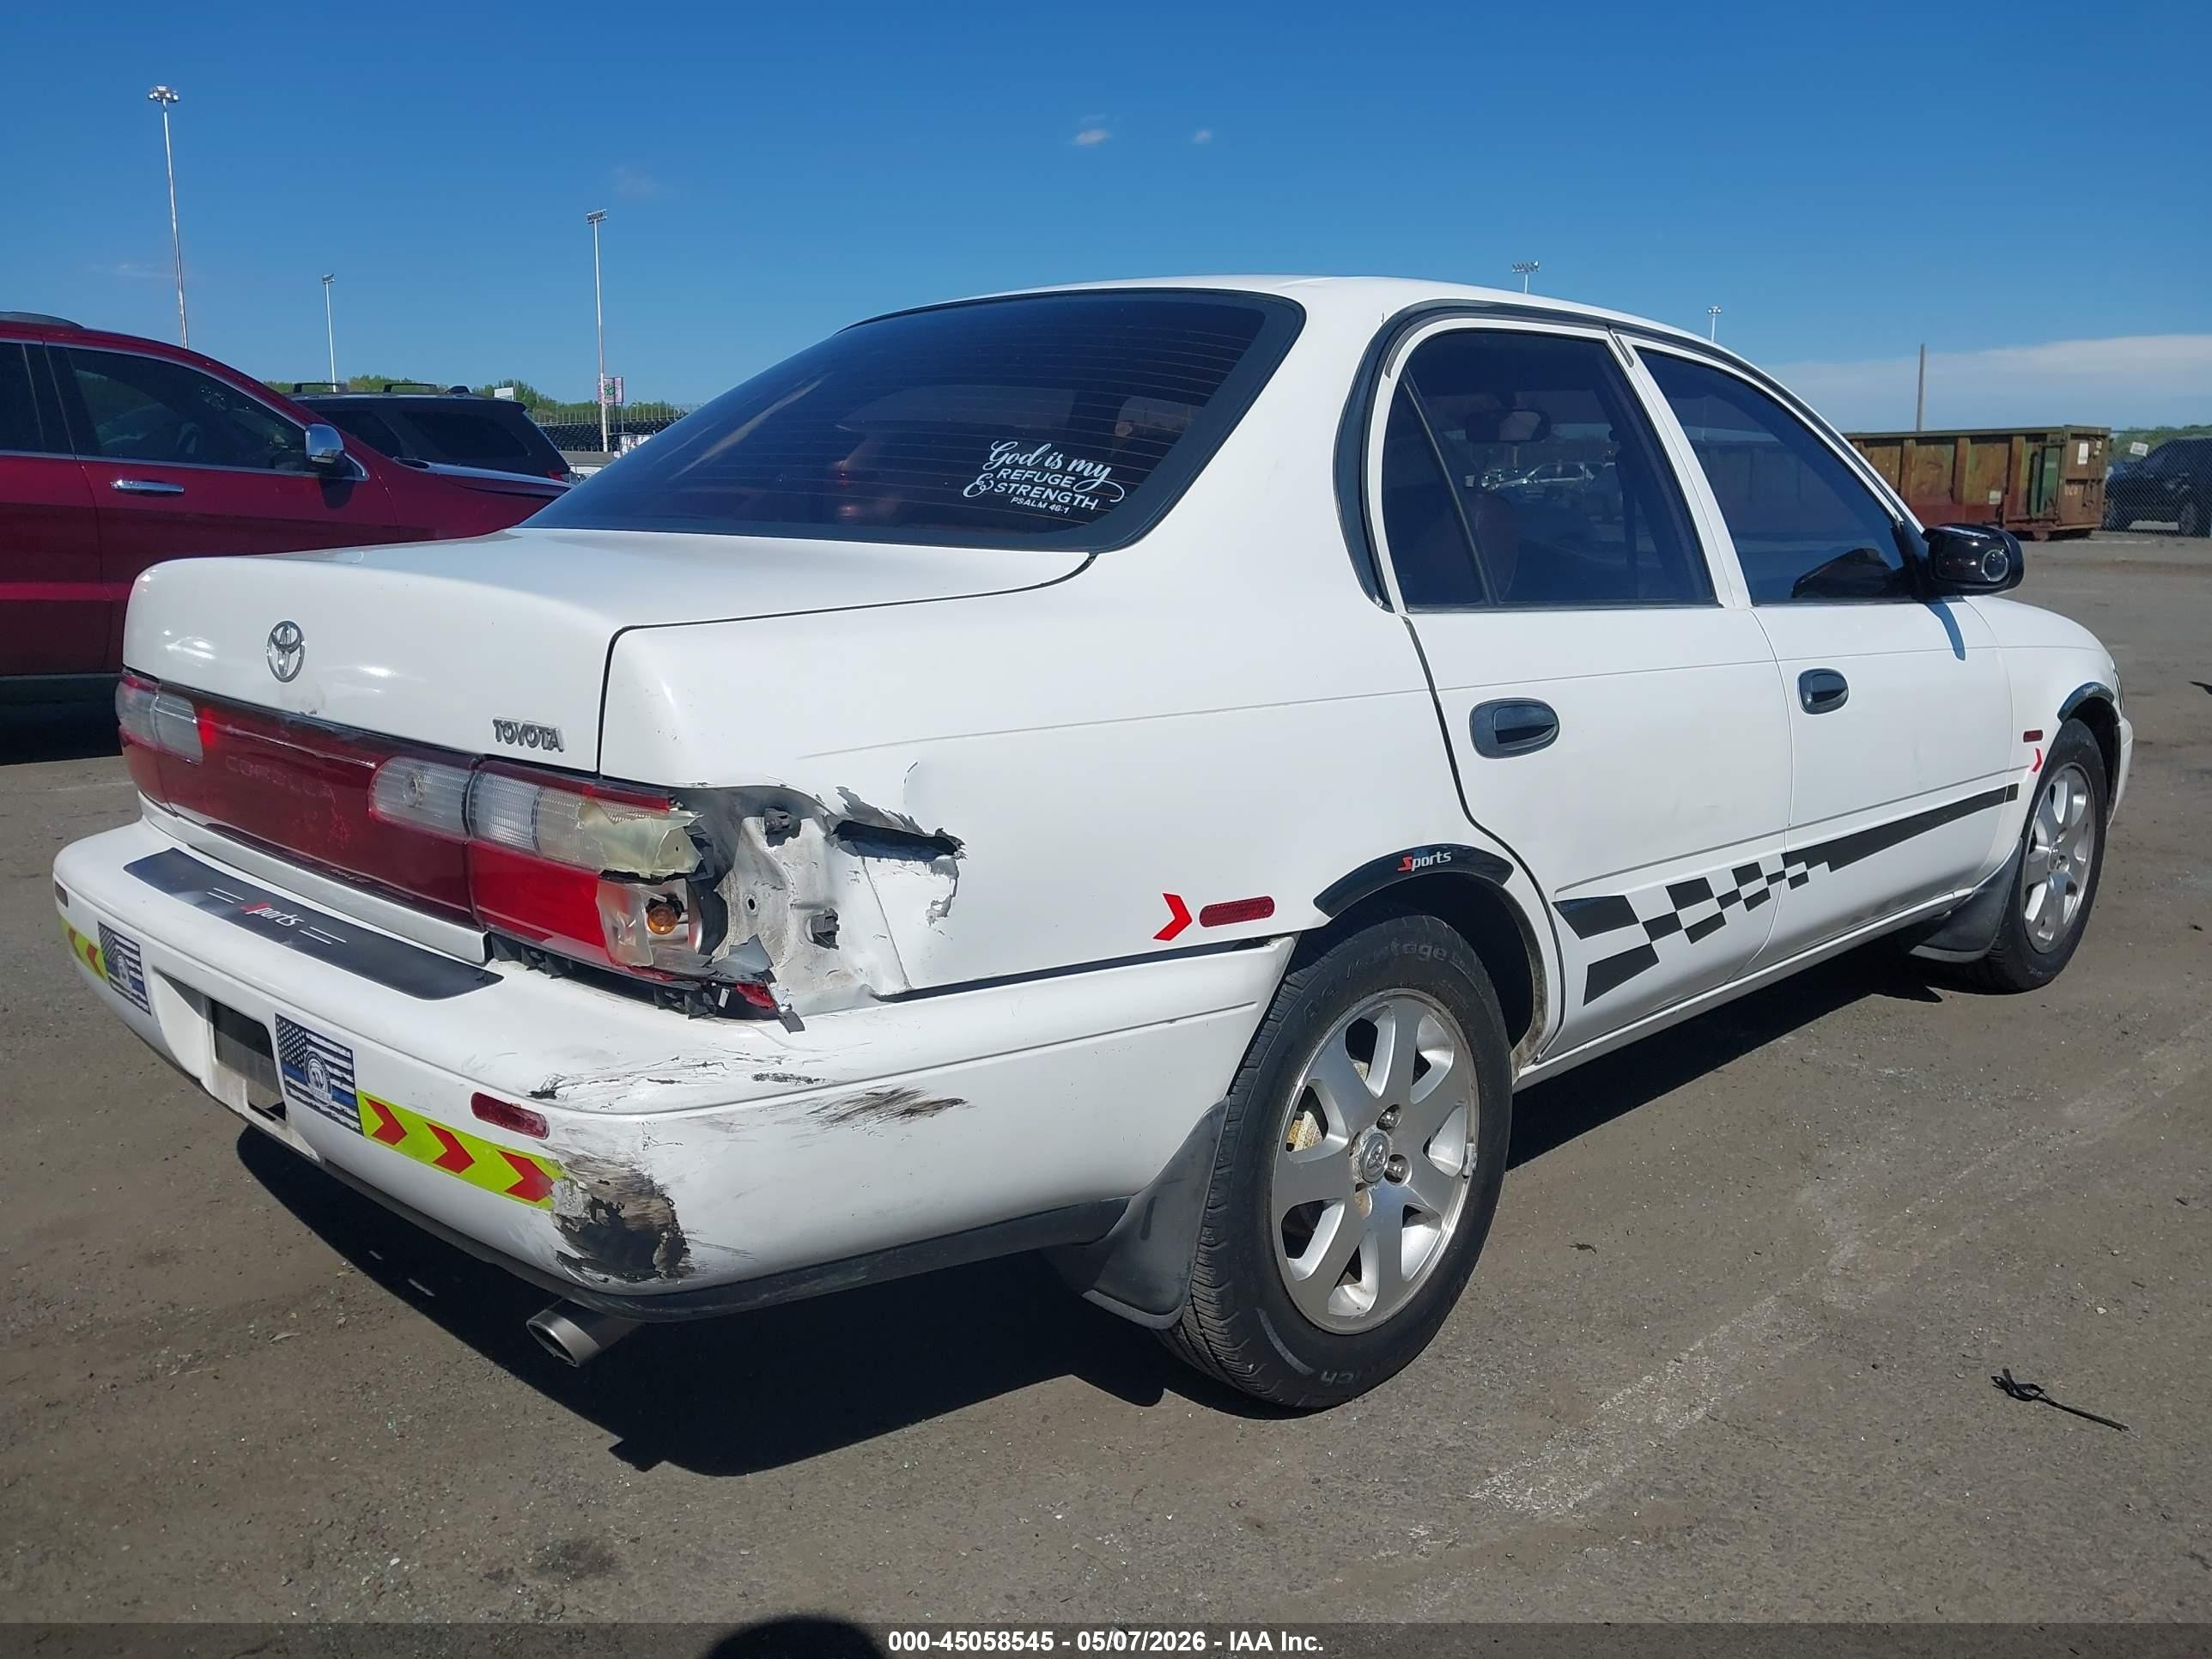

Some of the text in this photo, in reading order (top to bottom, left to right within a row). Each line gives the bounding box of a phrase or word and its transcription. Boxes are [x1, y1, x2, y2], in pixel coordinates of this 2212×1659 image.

[982, 441, 1125, 502] God is my
[996, 468, 1075, 488] REFUGE
[963, 473, 1099, 510] & STRENGTH
[1010, 496, 1070, 514] PSALM 46:1
[492, 719, 564, 753] TOYOTA
[1397, 851, 1452, 872] Sports
[240, 902, 305, 927] Sports
